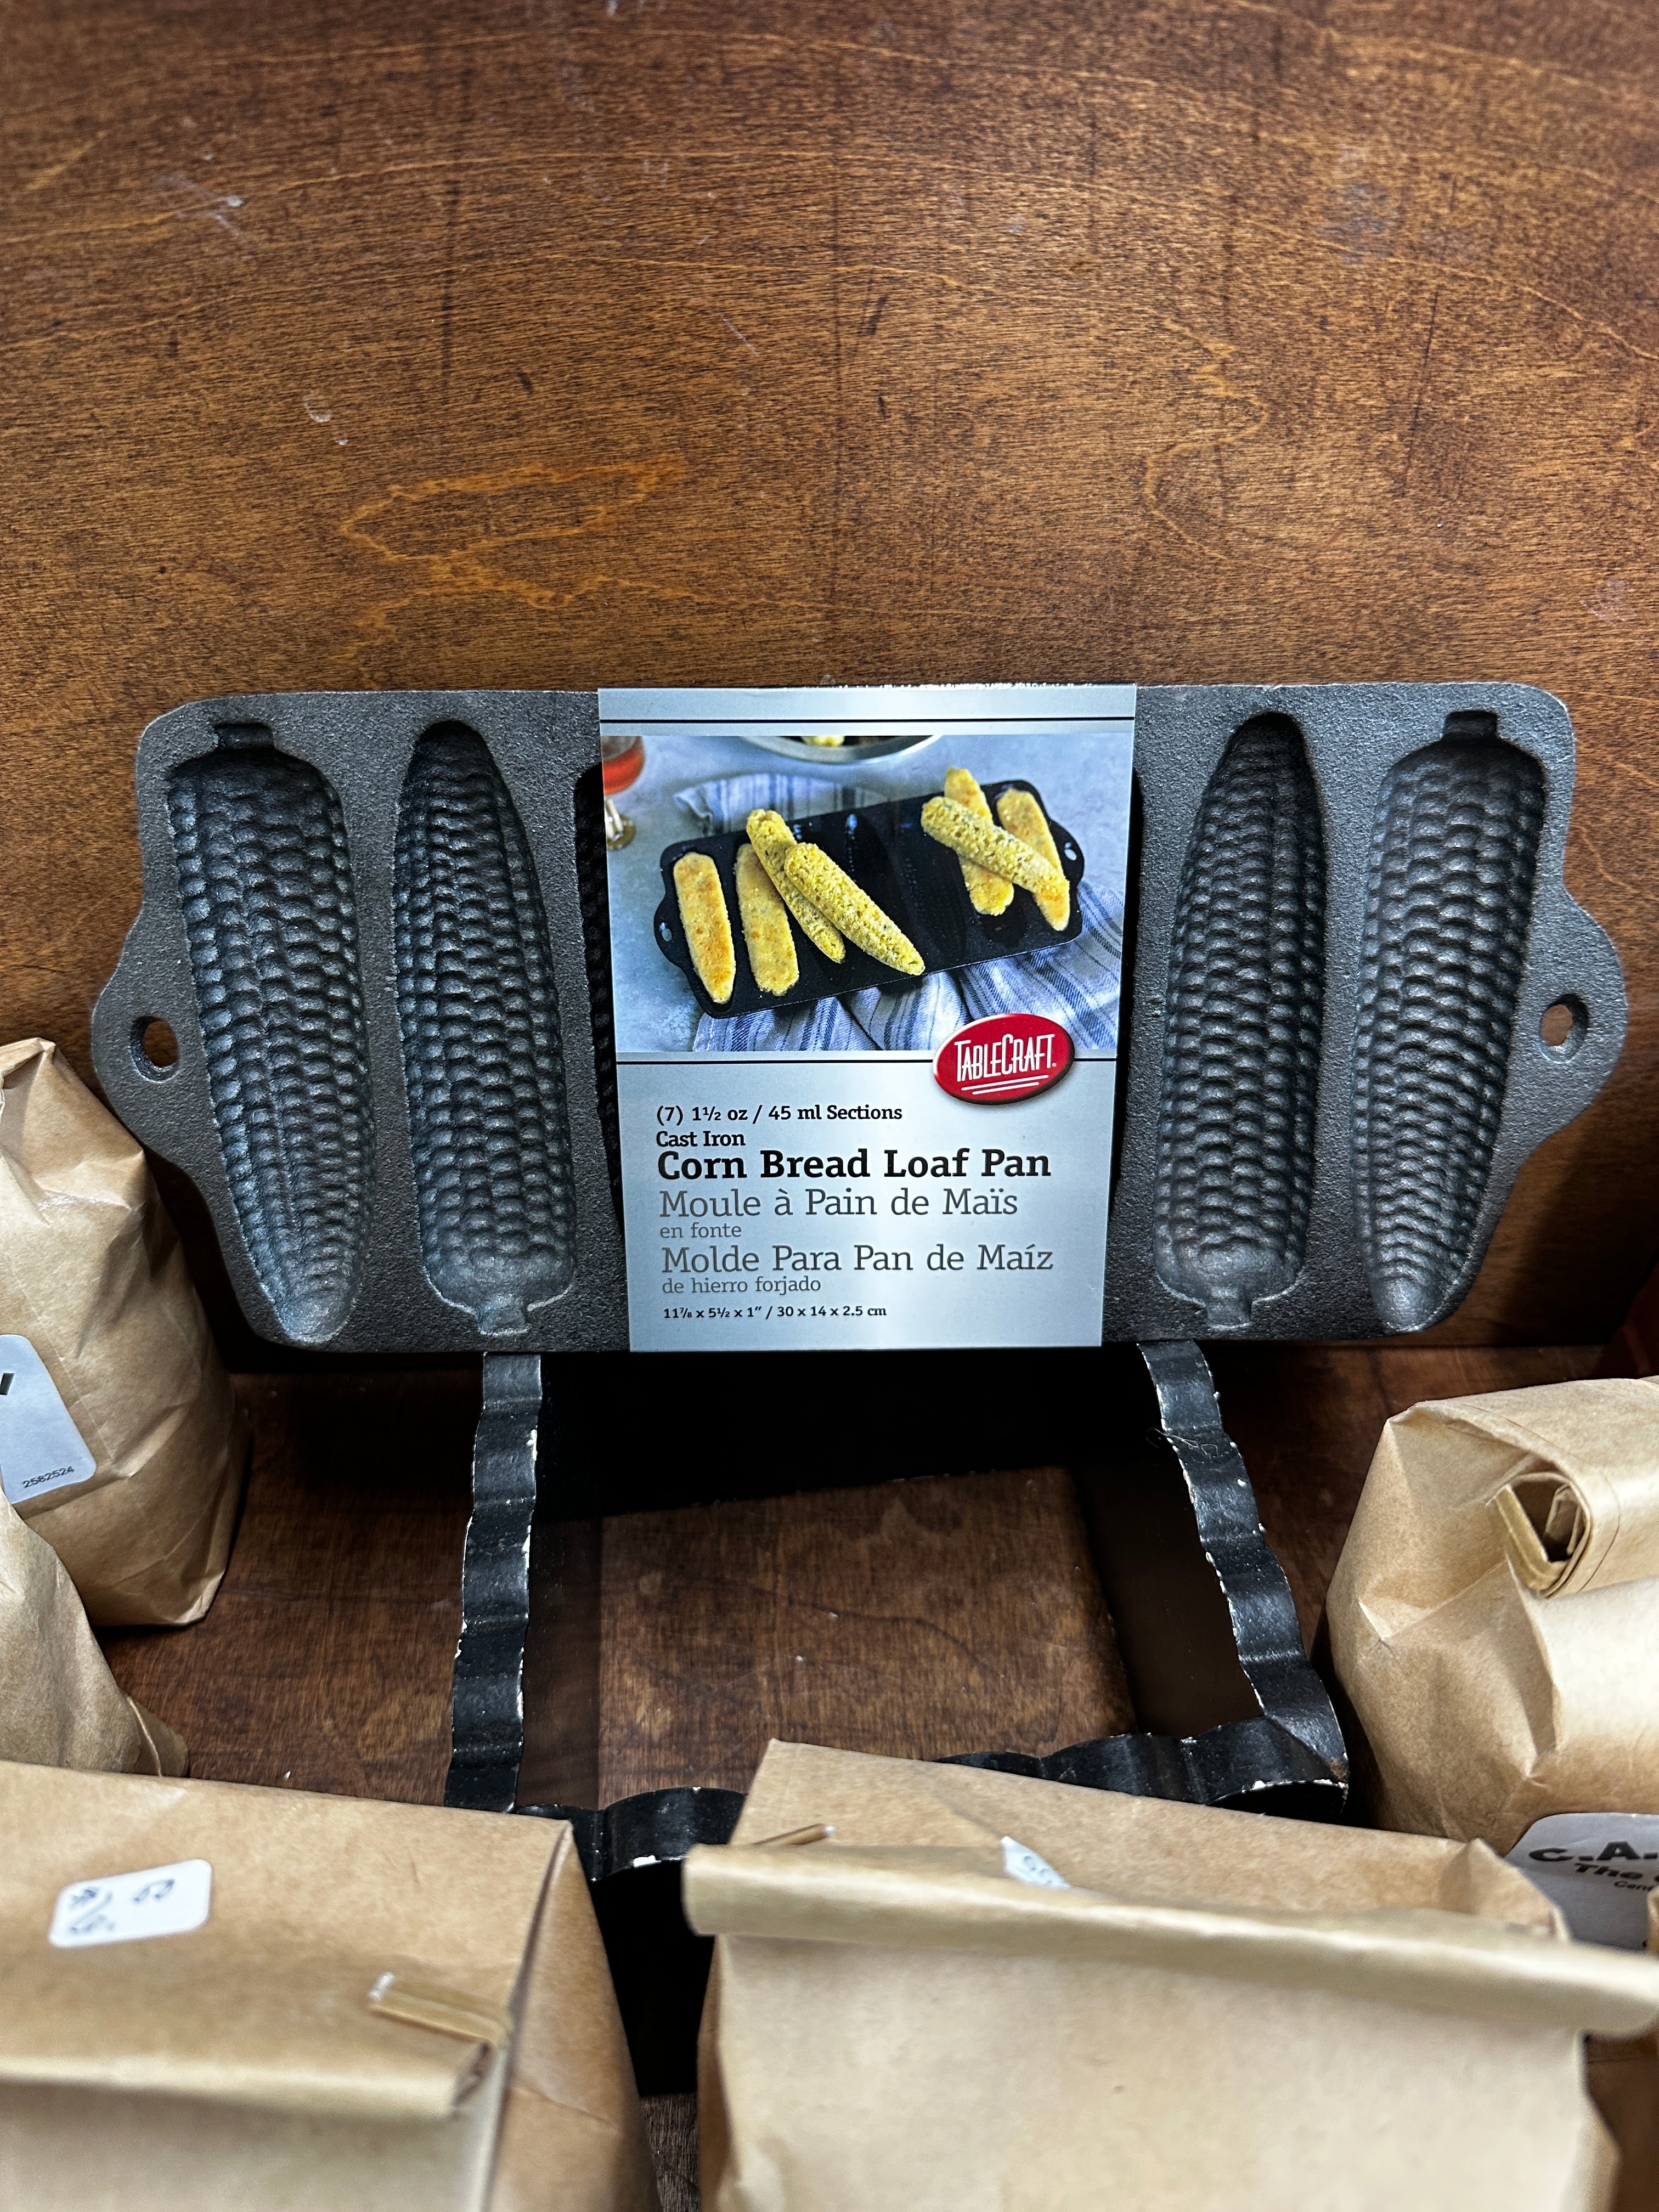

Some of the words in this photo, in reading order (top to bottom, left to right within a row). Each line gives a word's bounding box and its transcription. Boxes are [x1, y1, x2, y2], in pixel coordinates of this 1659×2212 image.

[657, 1105, 684, 1126] (7)
[727, 1109, 748, 1121] oz
[752, 1105, 763, 1124] /
[768, 1105, 791, 1120] 45
[797, 1105, 822, 1120] ml
[827, 1104, 902, 1120] Sections
[656, 1131, 698, 1147] Cast
[703, 1131, 746, 1146] Iron
[658, 1150, 747, 1180] Corn
[760, 1148, 870, 1178] Bread
[884, 1148, 970, 1177] Loaf
[981, 1149, 1051, 1177] Pan
[660, 1188, 761, 1217] Moule
[775, 1188, 793, 1215] à
[805, 1187, 877, 1215] Pain
[891, 1187, 929, 1215] de
[942, 1187, 1018, 1215] Maïs
[660, 1226, 684, 1238] en
[691, 1222, 742, 1238] fonte
[662, 1245, 759, 1273] Molde
[772, 1245, 842, 1271] Para
[854, 1244, 913, 1270] Pan
[927, 1244, 964, 1270] de
[977, 1243, 1054, 1270] Maíz
[662, 1278, 684, 1293] de
[691, 1278, 748, 1293] hierro
[755, 1276, 821, 1295] forjado
[696, 1310, 705, 1318] x
[734, 1309, 742, 1317] x
[765, 1306, 773, 1319] /
[777, 1306, 794, 1317] 30
[797, 1308, 806, 1316] x
[810, 1306, 826, 1316] 14
[830, 1307, 839, 1316] x
[843, 1306, 863, 1316] 2.5
[22, 1466, 75, 1488] 2582524
